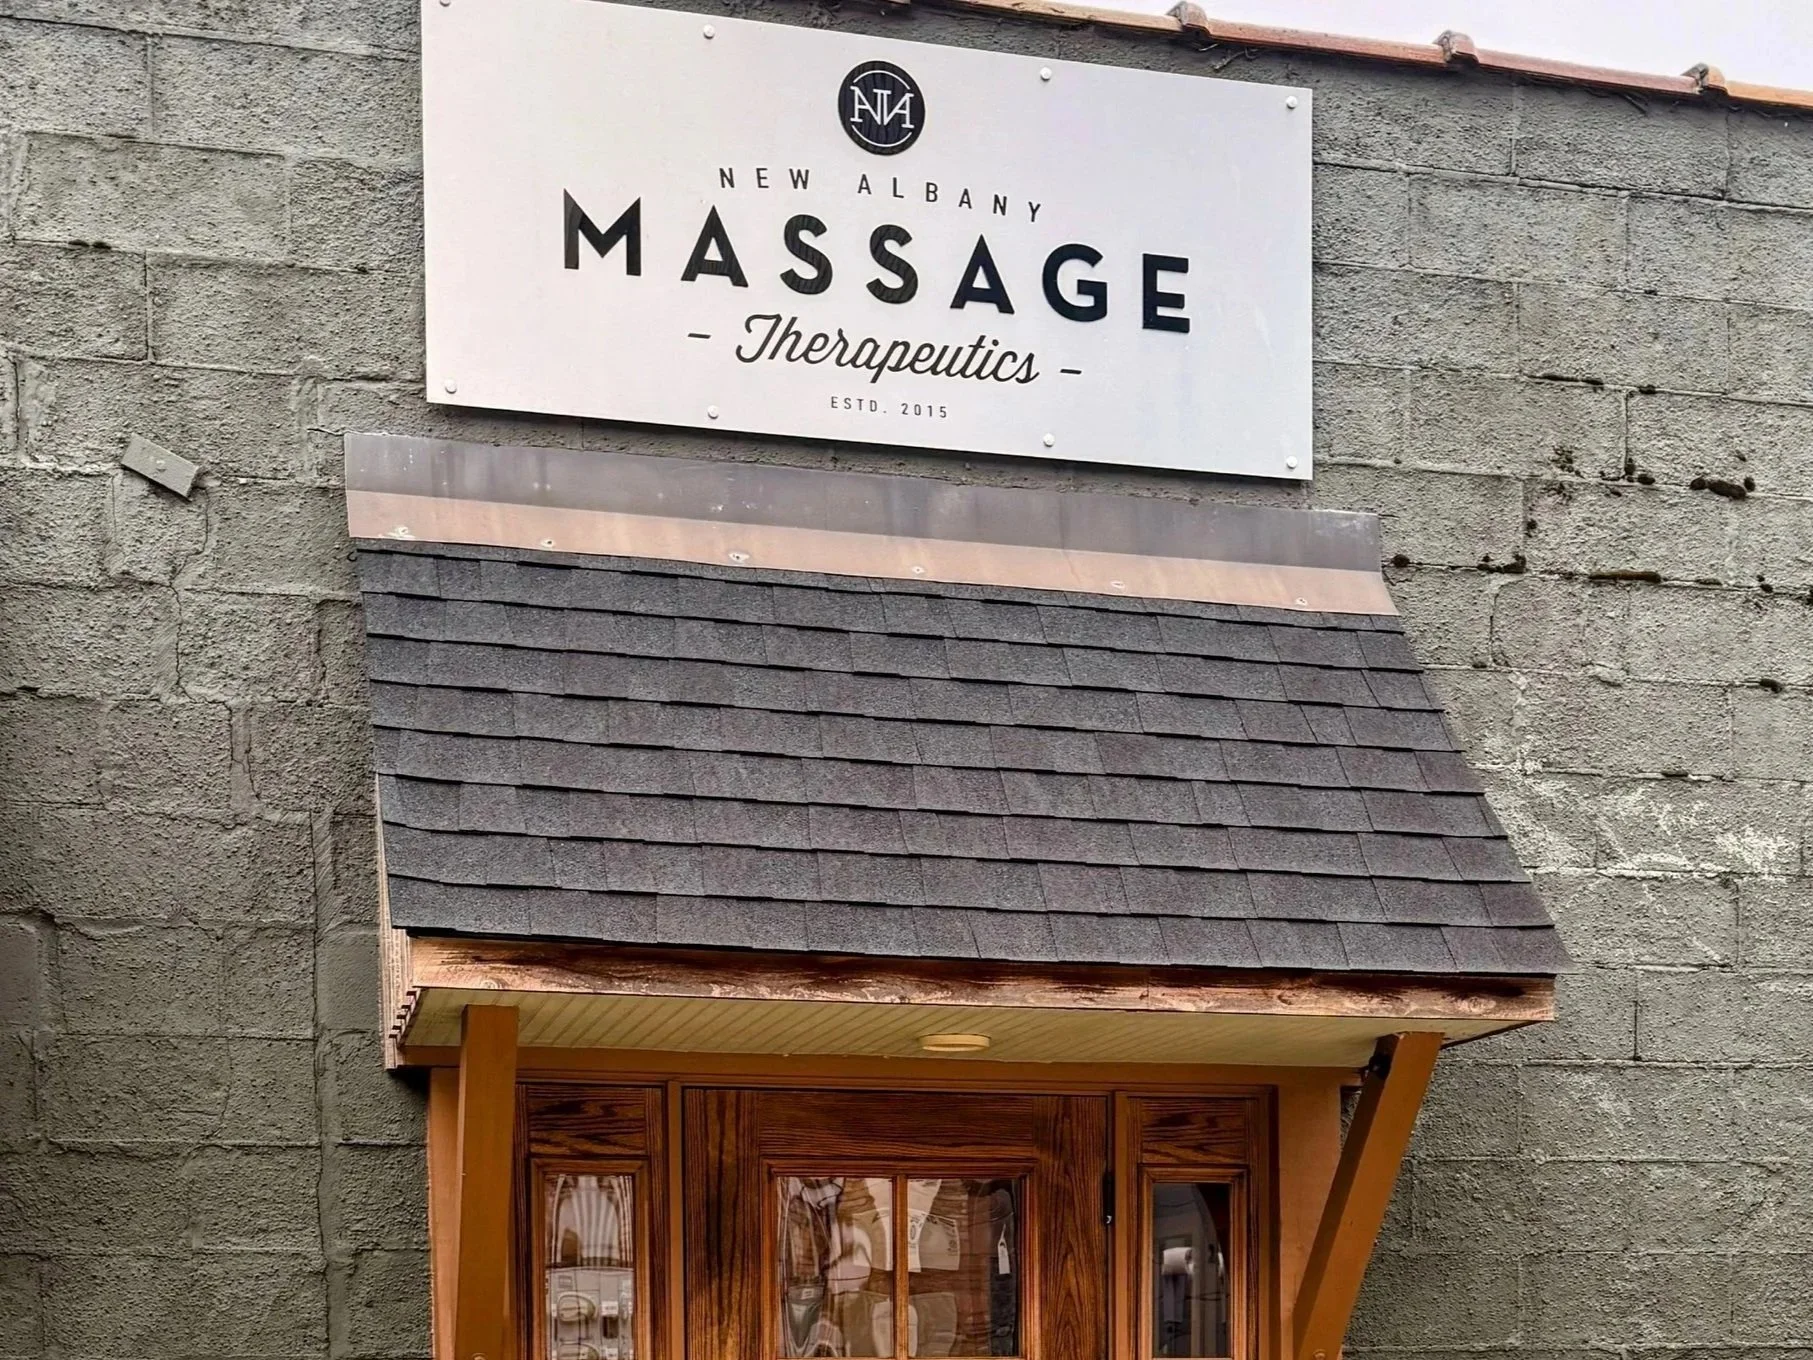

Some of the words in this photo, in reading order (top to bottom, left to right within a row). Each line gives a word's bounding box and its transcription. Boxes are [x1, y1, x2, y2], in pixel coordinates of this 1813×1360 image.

[719, 167, 811, 190] NEW
[857, 173, 1043, 223] ALBANY
[563, 188, 1191, 335] MASSAGE
[735, 313, 1040, 385] Therapeutics
[830, 395, 887, 414] ESTD.
[900, 402, 949, 418] 2015
